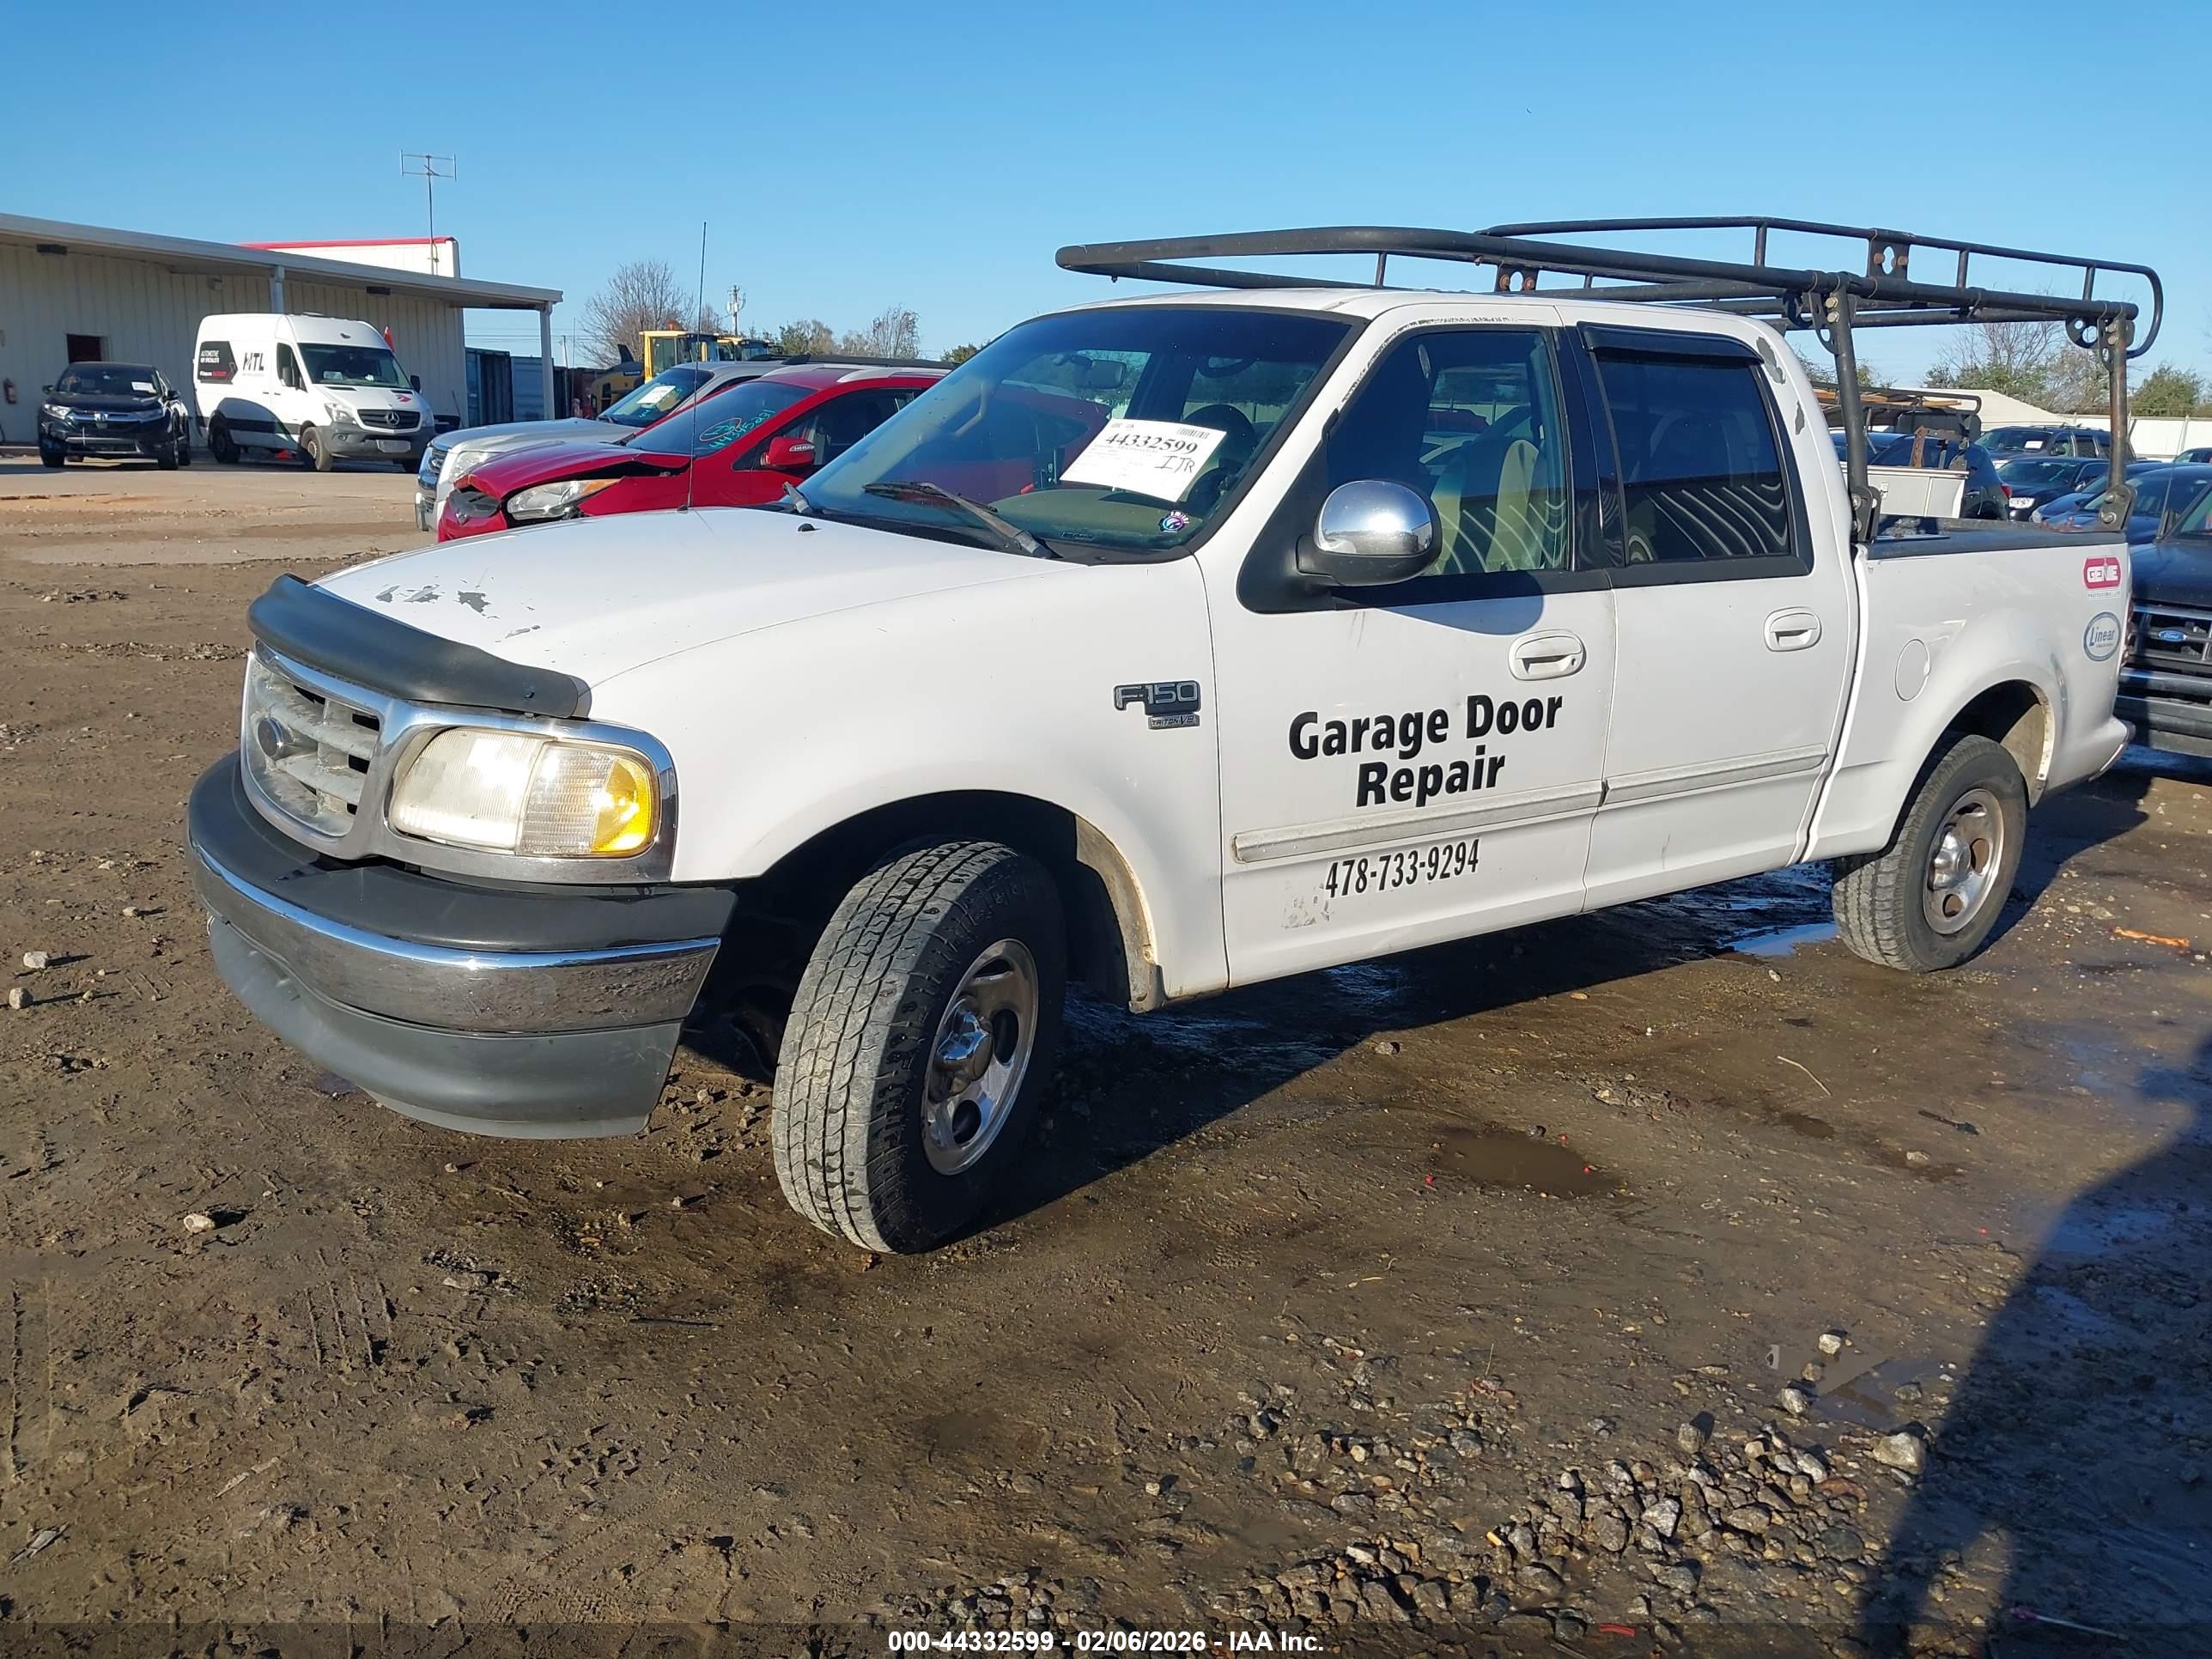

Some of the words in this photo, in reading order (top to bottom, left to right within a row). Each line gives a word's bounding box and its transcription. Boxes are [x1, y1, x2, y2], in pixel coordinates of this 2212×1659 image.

[1106, 433, 1198, 455] 44332599
[2088, 626, 2115, 647] Linear
[1115, 682, 1198, 708] F-150
[1180, 714, 1194, 725] V8
[1289, 708, 1449, 760] Garage
[1465, 694, 1563, 738] Door
[1356, 745, 1506, 808] Repair
[1325, 838, 1480, 898] 478-733-9294
